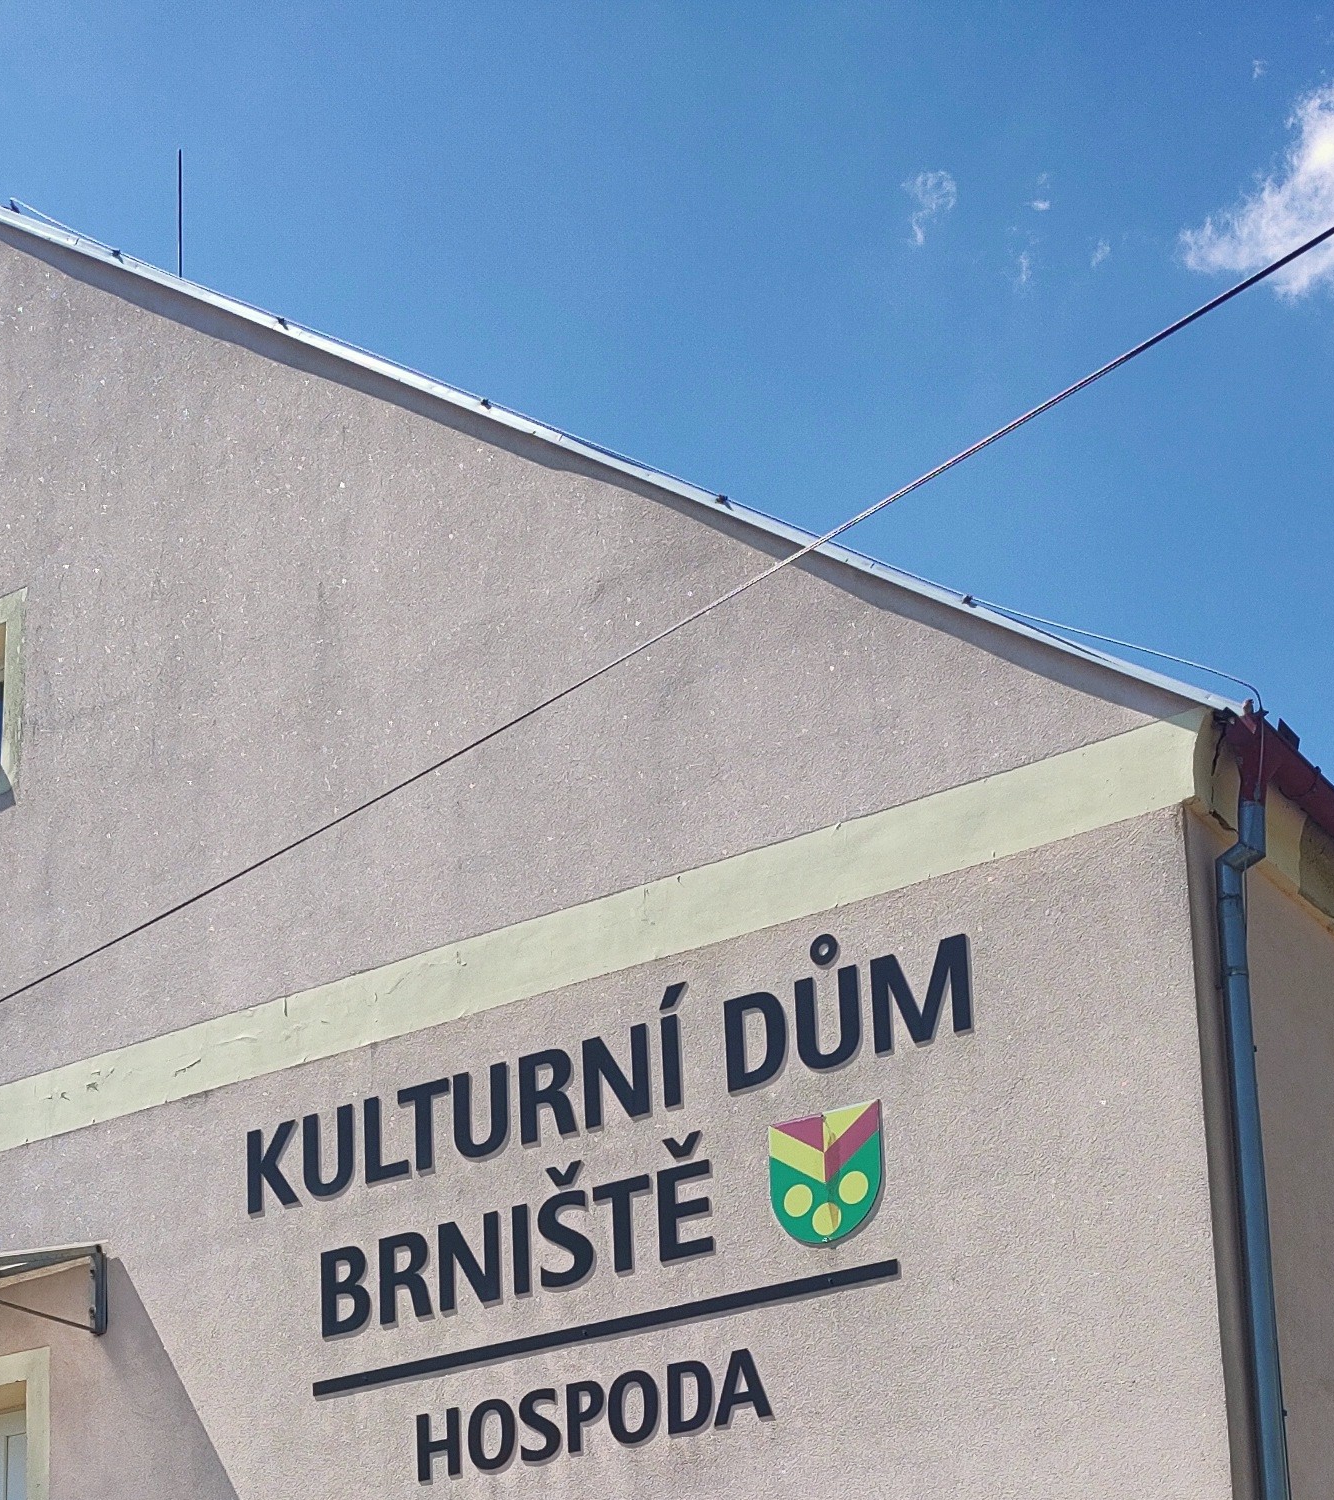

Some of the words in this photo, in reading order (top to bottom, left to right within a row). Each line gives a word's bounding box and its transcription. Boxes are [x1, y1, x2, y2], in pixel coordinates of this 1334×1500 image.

[246, 982, 687, 1215] KULTURNÍ
[724, 933, 972, 1092] DŮM
[320, 1131, 714, 1337] BRNIŠTĚ
[417, 1348, 772, 1483] HOSPODA
